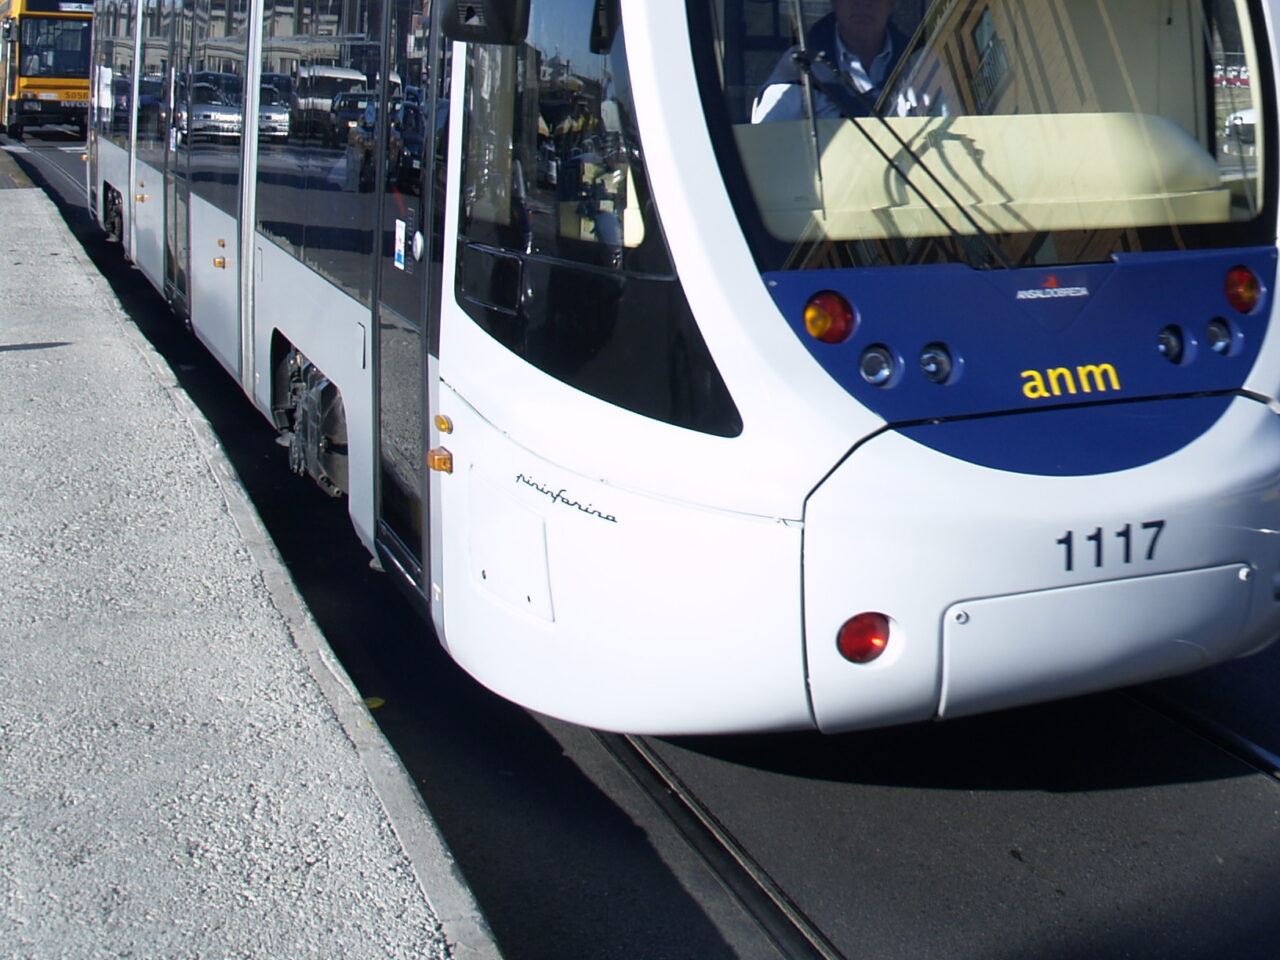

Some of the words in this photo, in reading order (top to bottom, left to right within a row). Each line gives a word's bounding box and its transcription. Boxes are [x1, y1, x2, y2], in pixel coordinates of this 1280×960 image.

[1021, 362, 1121, 399] anm
[516, 473, 618, 524] pininfarina
[1056, 519, 1166, 572] 1117
